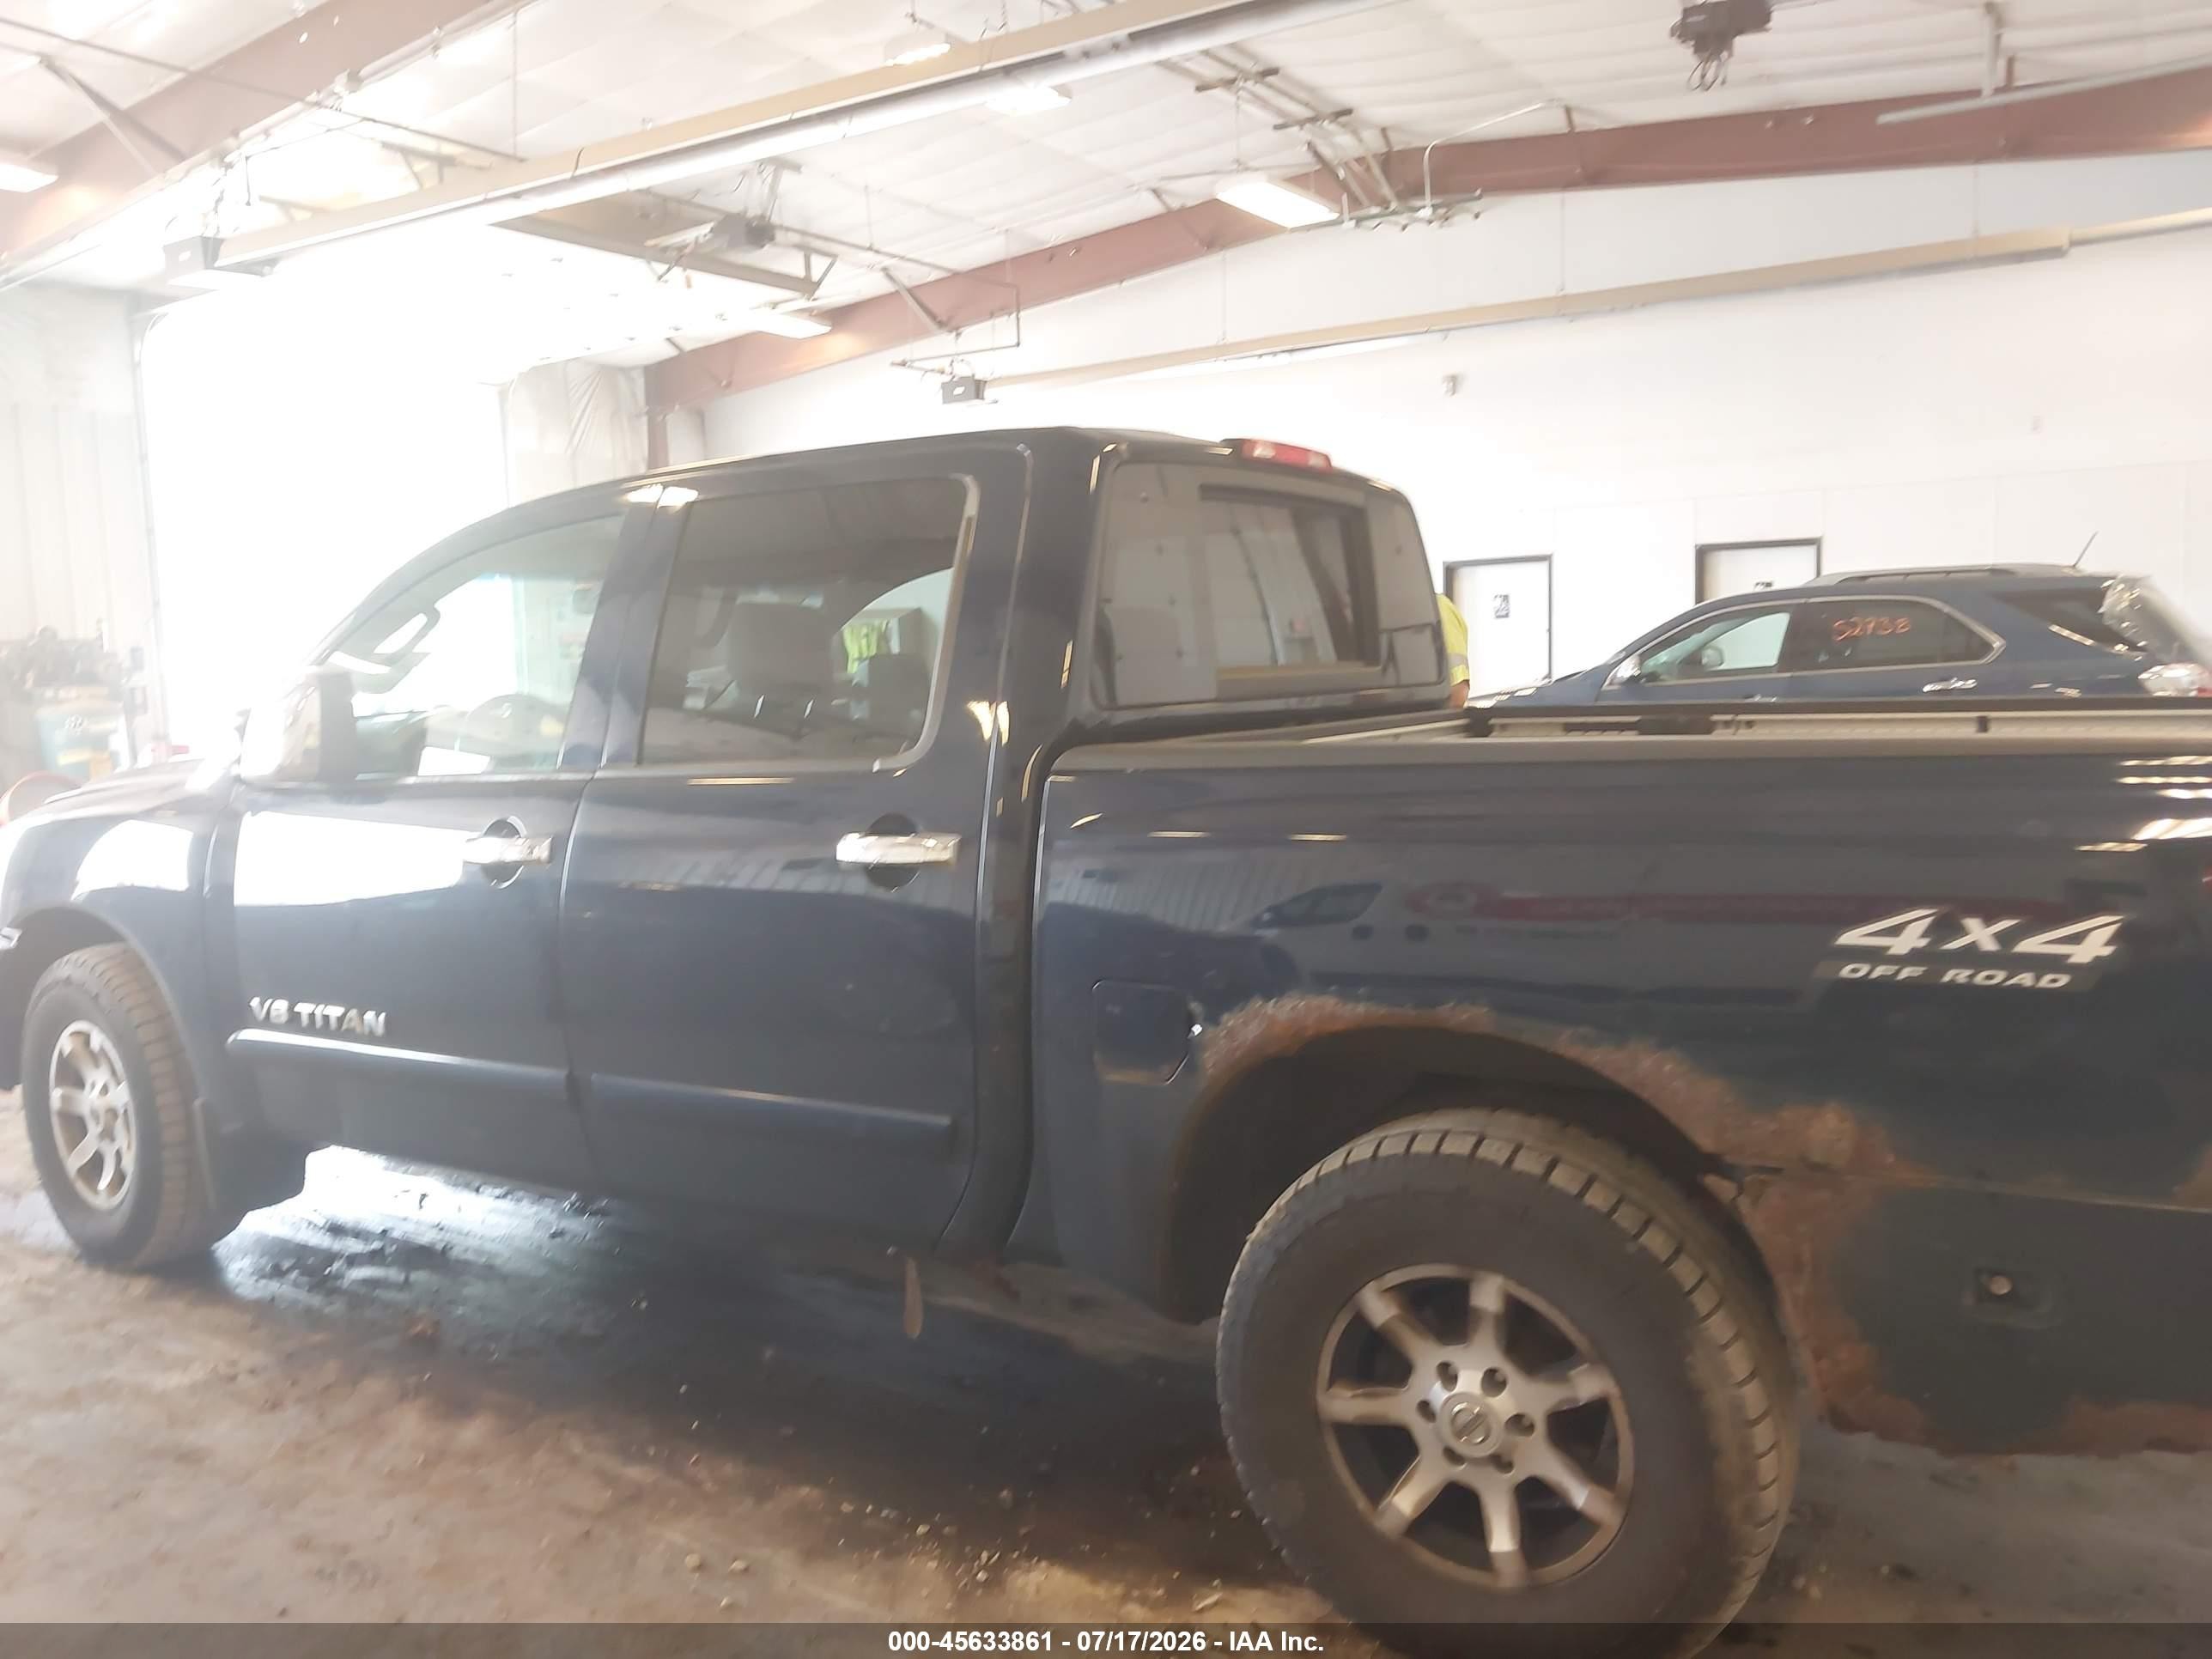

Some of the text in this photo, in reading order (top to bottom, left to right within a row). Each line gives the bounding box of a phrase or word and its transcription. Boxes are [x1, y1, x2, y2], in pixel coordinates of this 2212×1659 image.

[1838, 963, 2073, 988] OFF ROAD
[249, 996, 387, 1037] V8 TITAN
